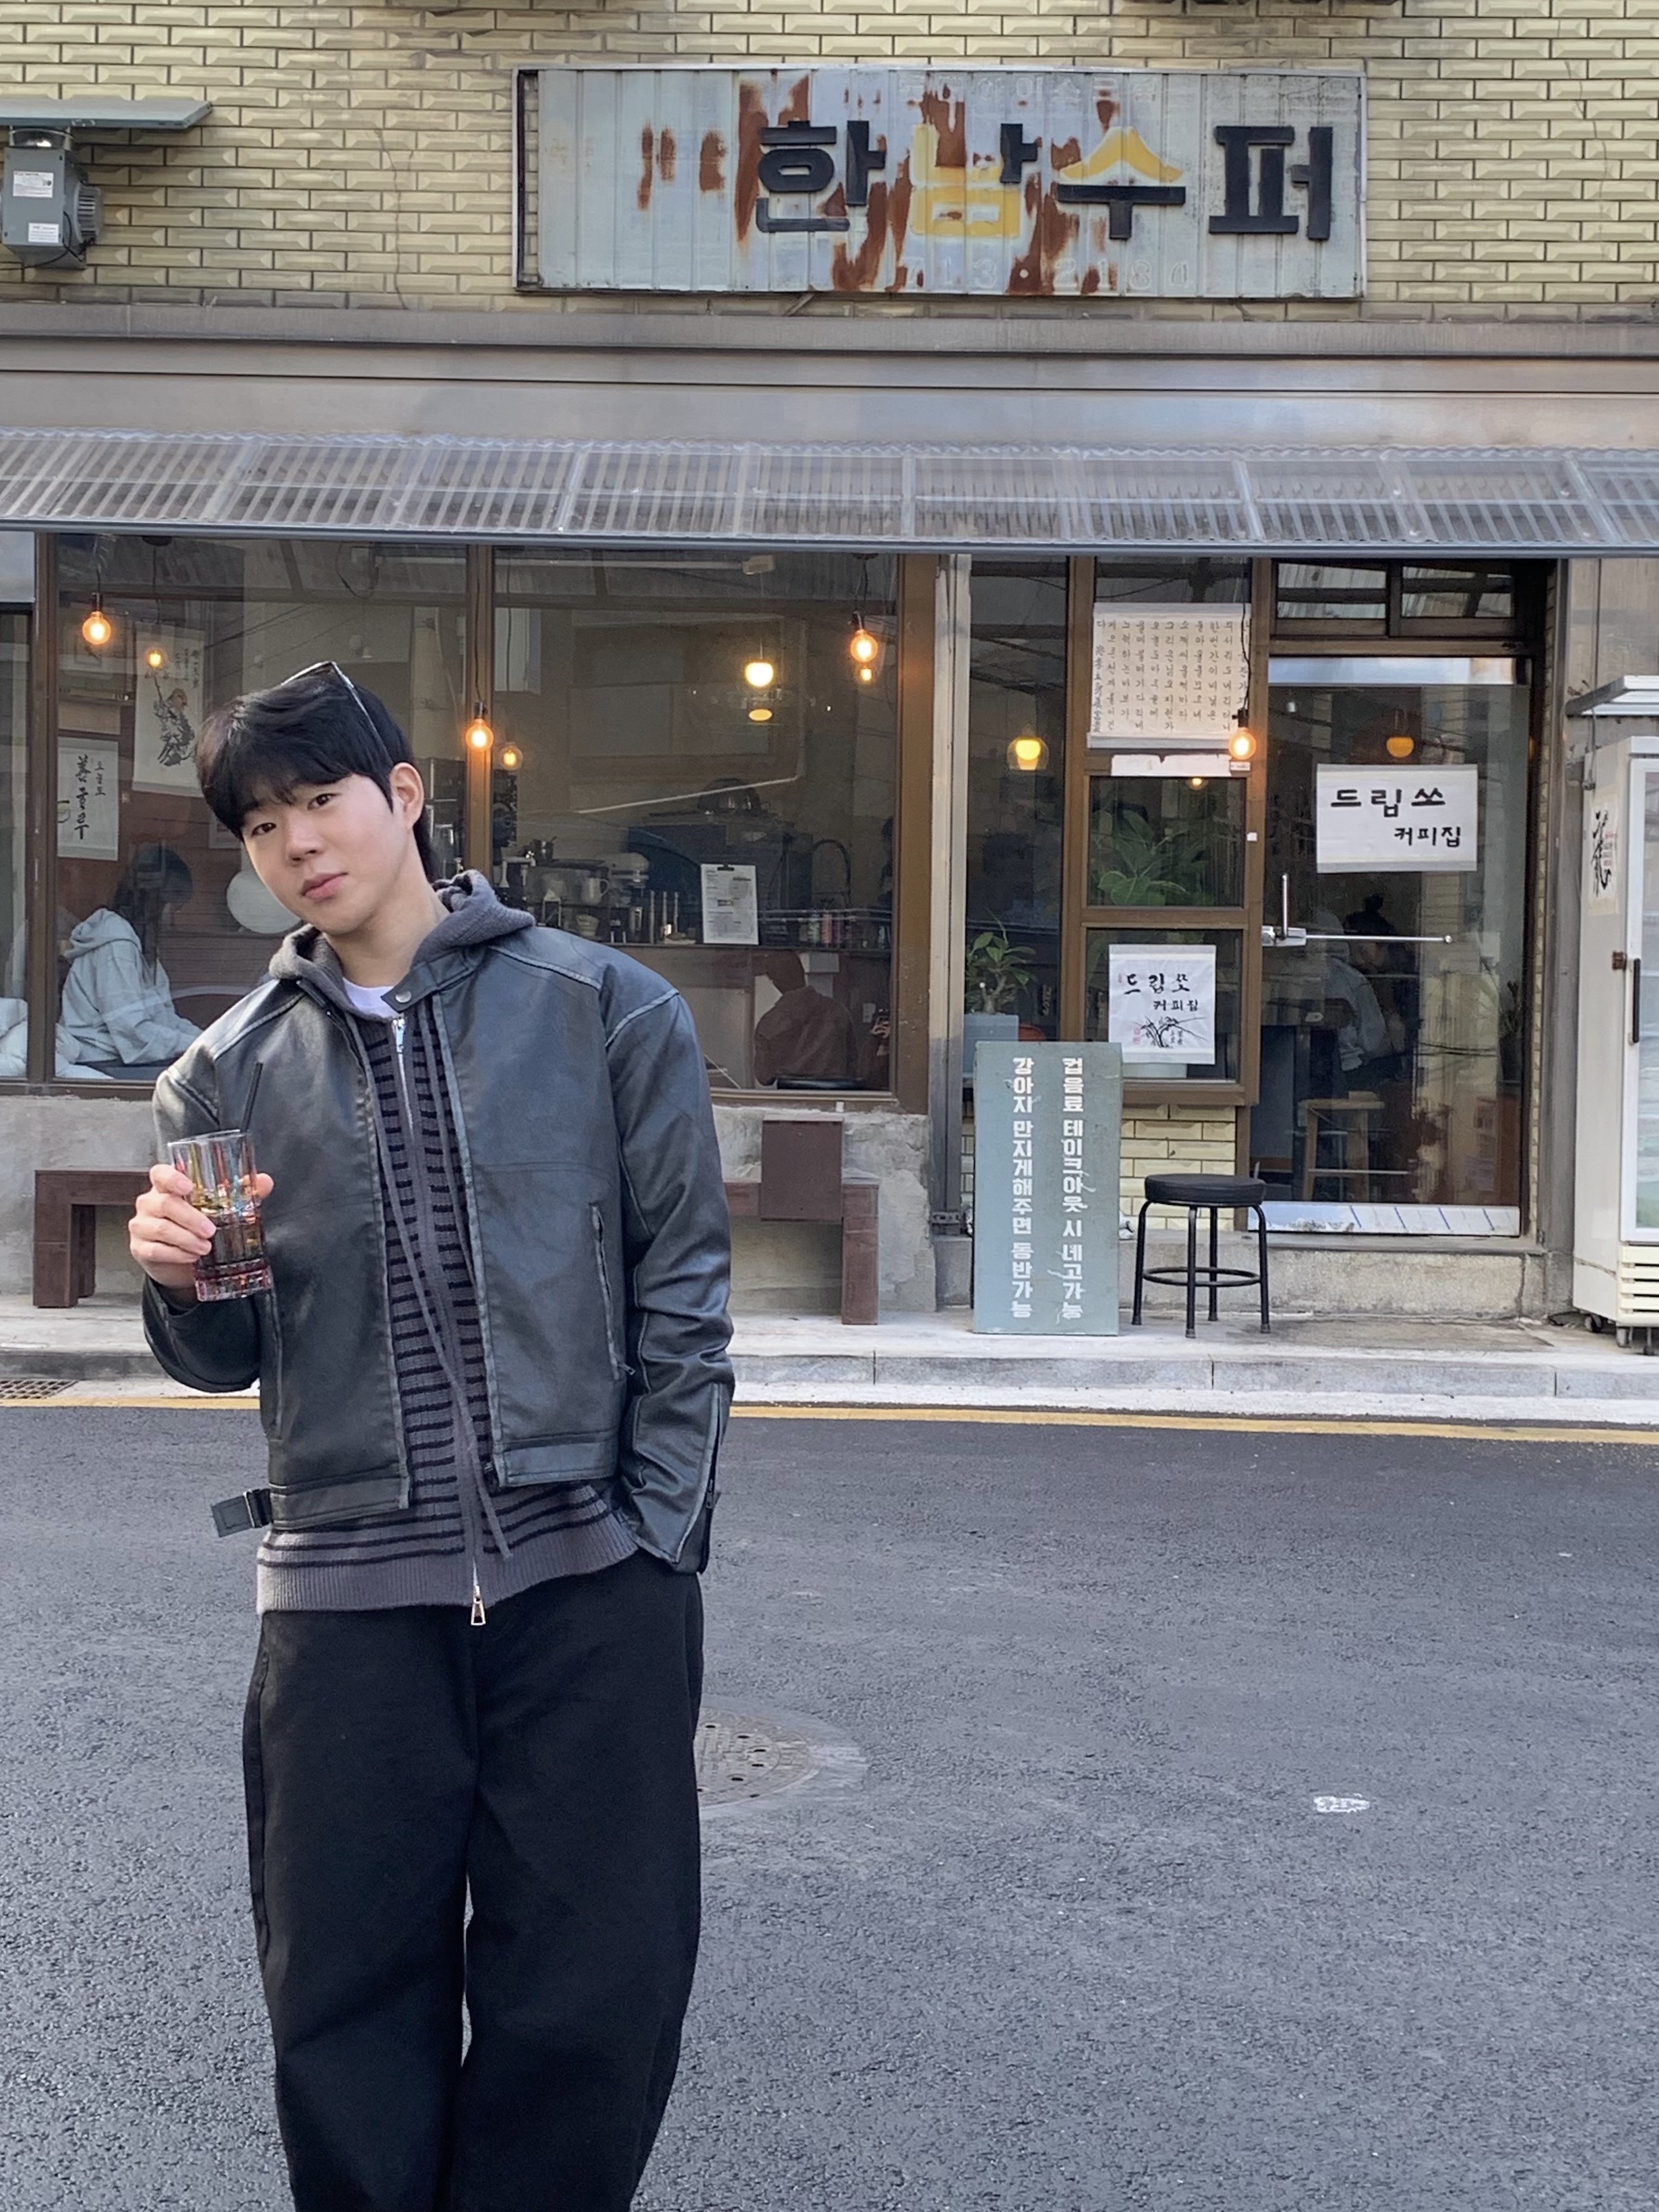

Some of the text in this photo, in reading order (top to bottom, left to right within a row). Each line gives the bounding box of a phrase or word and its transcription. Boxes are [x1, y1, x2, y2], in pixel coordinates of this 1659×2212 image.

[756, 118, 1334, 241] 한남수퍼
[1394, 826, 1461, 848] 커피집
[1153, 999, 1198, 1011] 커피집
[1062, 1057, 1083, 1113] 컵음료
[1011, 1057, 1034, 1319] 강아지 만지게해주면 동반가능
[1062, 1119, 1083, 1213] 테이크아웃
[1062, 1219, 1082, 1237] 시
